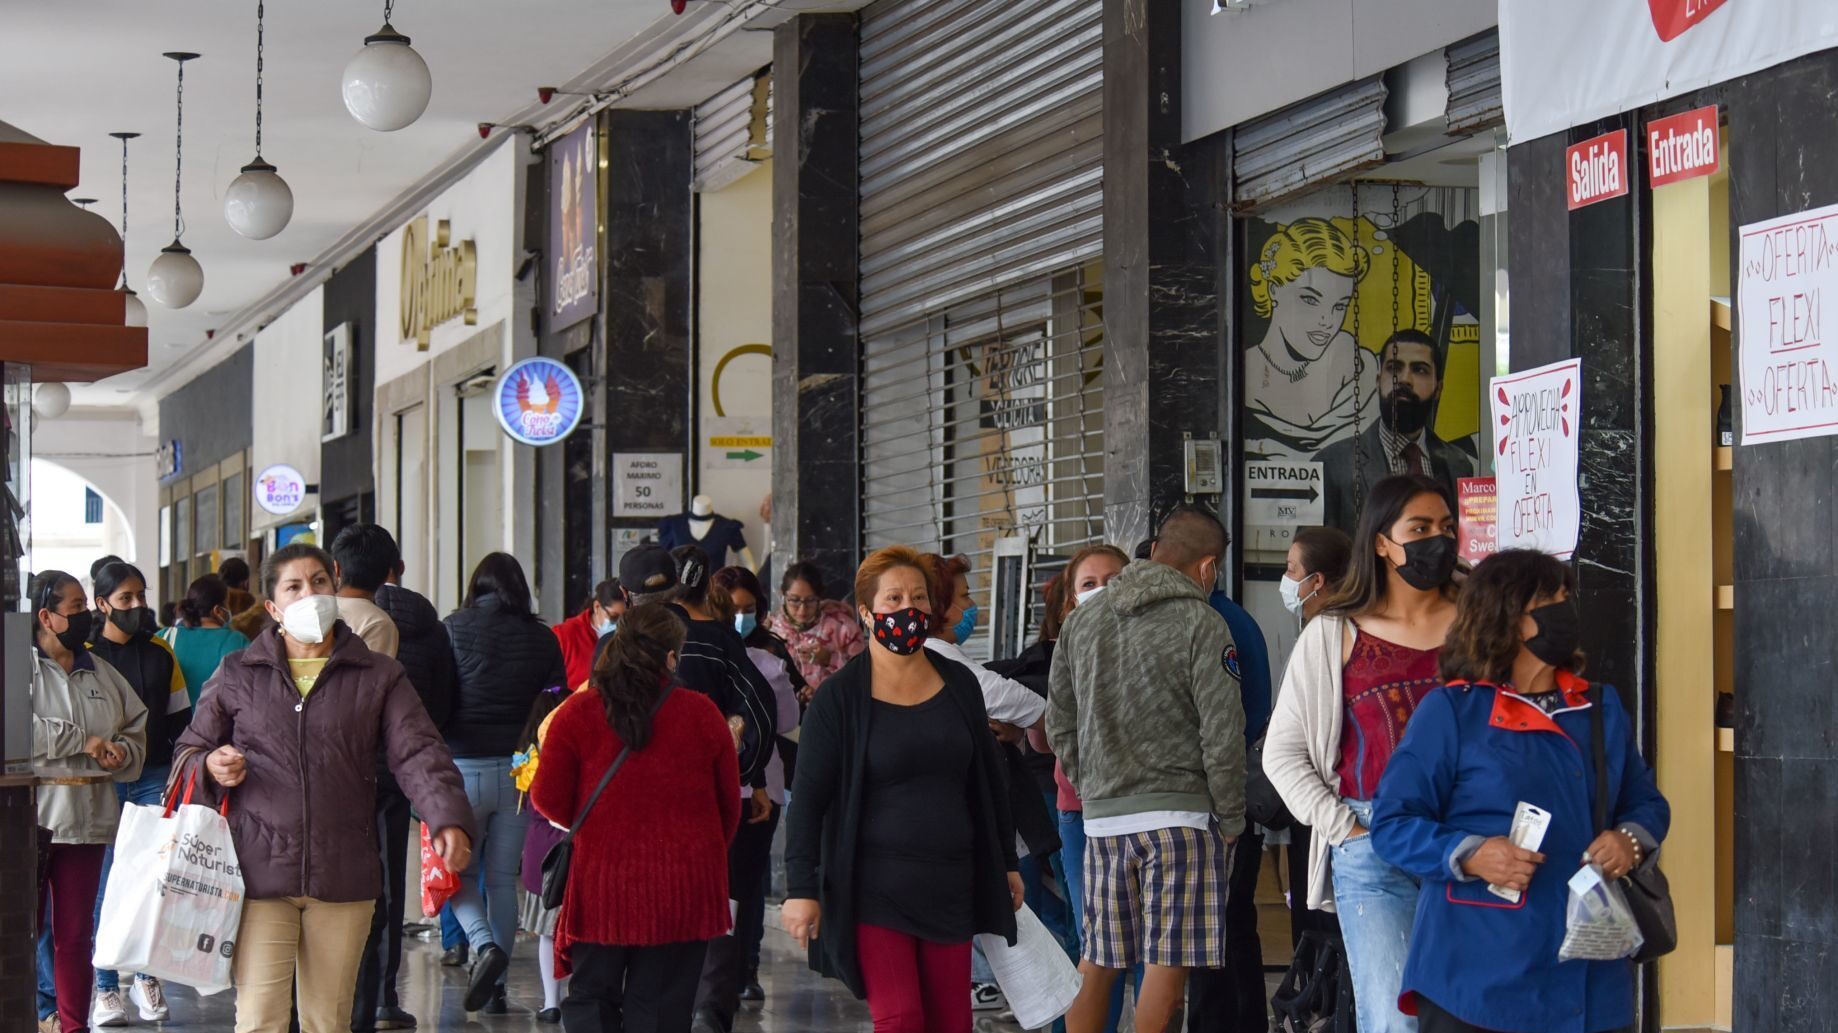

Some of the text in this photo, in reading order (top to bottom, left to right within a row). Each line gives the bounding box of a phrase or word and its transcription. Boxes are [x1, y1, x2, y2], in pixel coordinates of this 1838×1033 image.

[1651, 118, 1715, 178] Entrada
[1571, 141, 1620, 203] Salida
[1762, 222, 1830, 282] OFERTA
[1768, 287, 1820, 349] FLEXI
[1764, 359, 1834, 416] OFERTA
[630, 461, 658, 469] AFORO
[1248, 465, 1321, 481] ENTRADA
[1511, 438, 1552, 475] FLEXI
[626, 472, 662, 480] MAXIMO
[635, 486, 652, 498] 50
[1525, 472, 1538, 495] EN
[623, 502, 665, 510] PERSONAS
[1512, 492, 1555, 538] OFERTA
